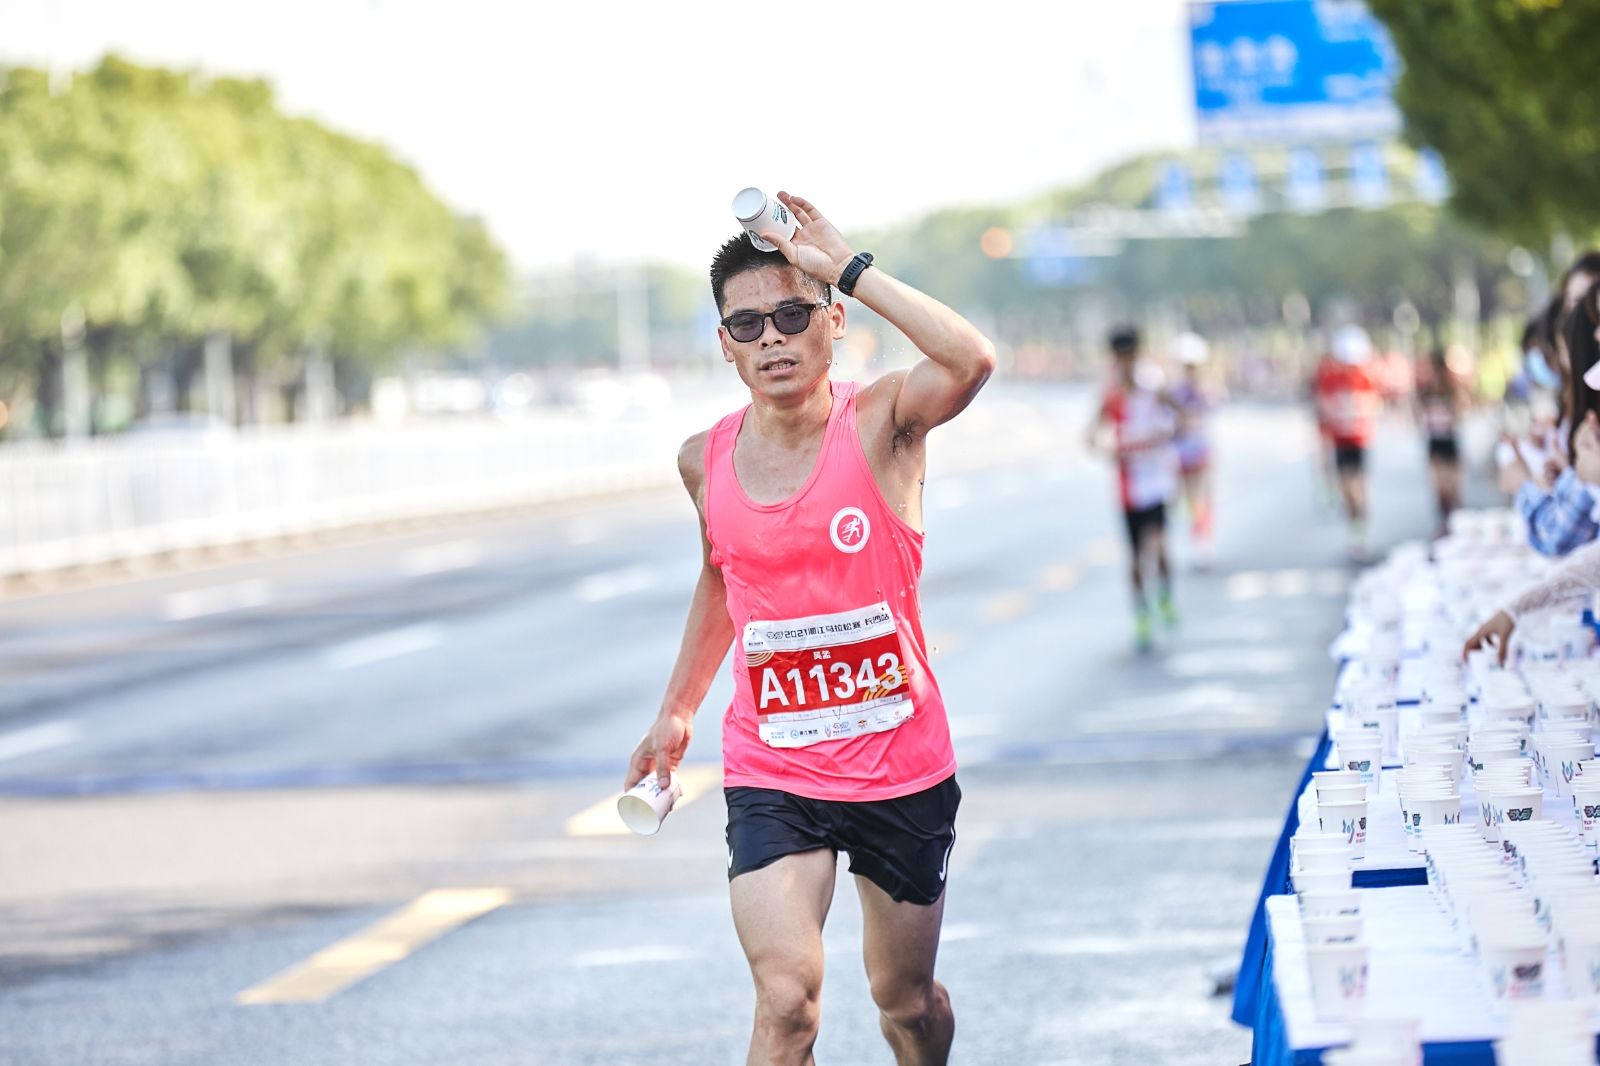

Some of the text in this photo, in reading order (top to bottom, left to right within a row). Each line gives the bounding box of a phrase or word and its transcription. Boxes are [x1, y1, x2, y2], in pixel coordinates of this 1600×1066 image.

[864, 613, 890, 626] 长沙站
[759, 652, 903, 709] A11343
